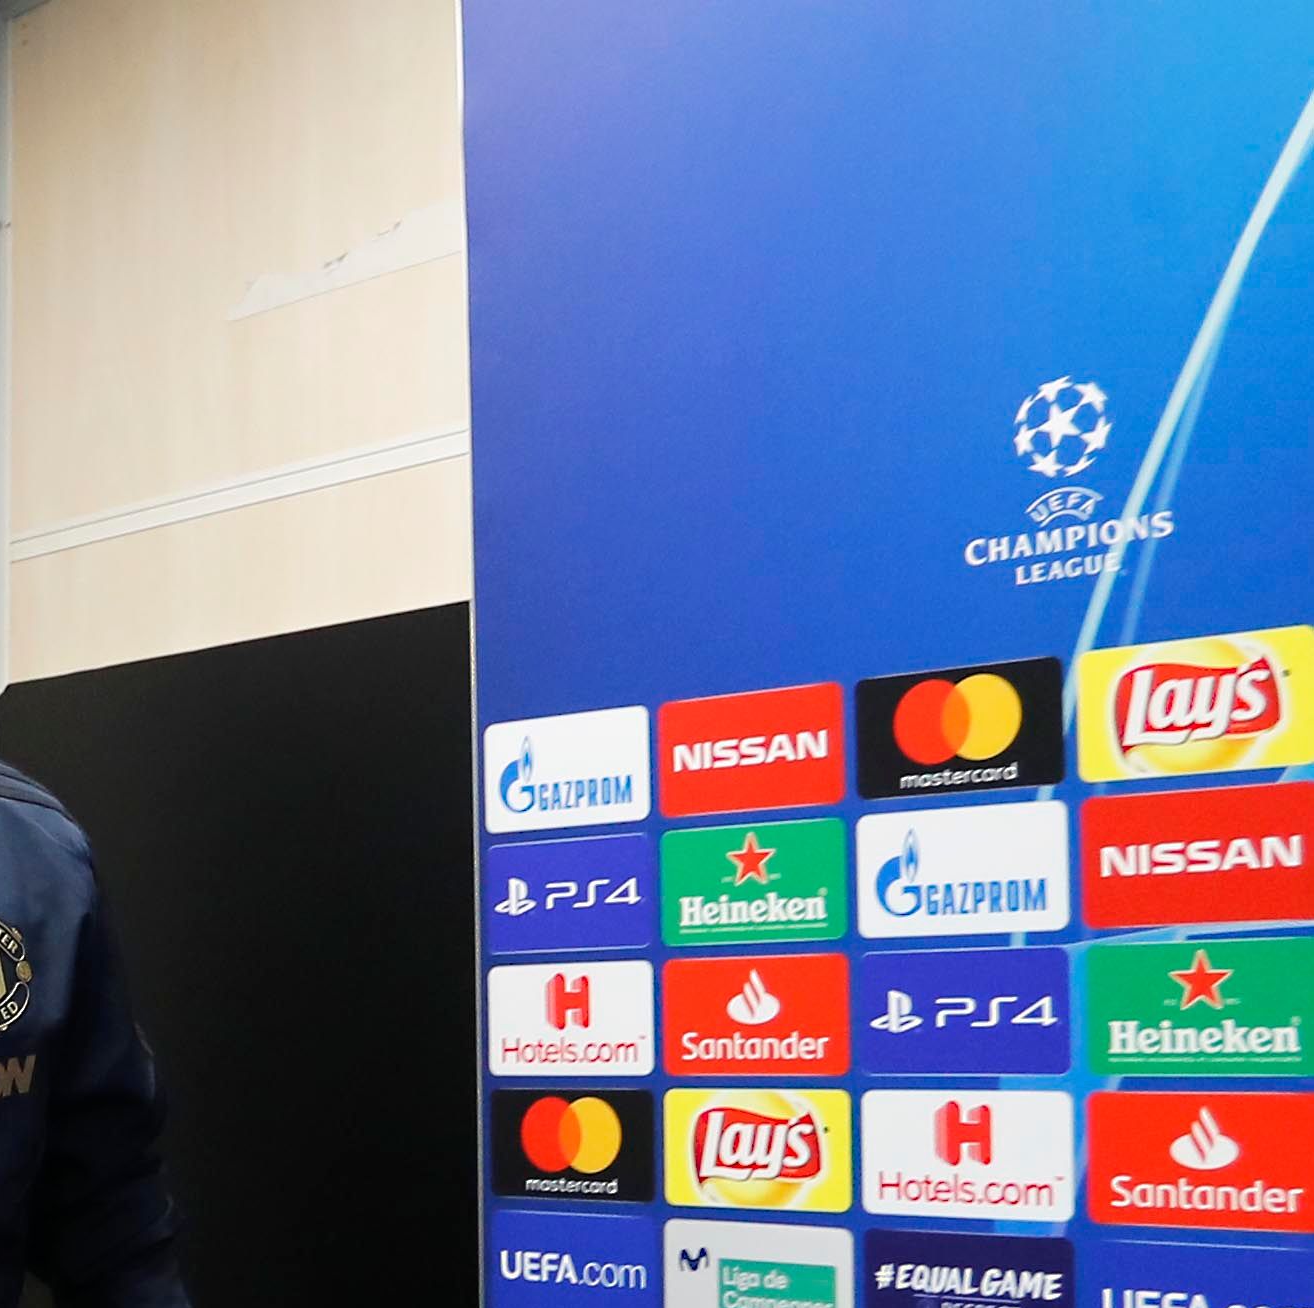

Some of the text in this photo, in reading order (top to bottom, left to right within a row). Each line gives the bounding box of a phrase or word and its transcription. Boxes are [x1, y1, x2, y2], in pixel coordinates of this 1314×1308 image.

[1028, 493, 1096, 522] UEFA
[964, 510, 1174, 566] CHAMPIONS
[1015, 551, 1121, 585] LEAGUE
[1123, 667, 1271, 746] Lay's
[672, 729, 829, 773] NISSAN
[539, 774, 633, 812] GAZPROM
[899, 762, 1019, 790] mastercard
[1100, 835, 1304, 878] NISSAN
[545, 877, 642, 910] PS4
[679, 889, 828, 927] Heineken
[926, 878, 1047, 916] GAZPROM
[934, 995, 1059, 1028] PS4
[501, 1036, 639, 1064] Hotels.com
[681, 1032, 829, 1061] Santander
[1108, 1018, 1301, 1055] Heineken
[699, 1111, 816, 1181] Lay's
[525, 1177, 619, 1194] mastercard
[878, 1171, 1055, 1208] Hotels.com
[1110, 1175, 1304, 1214] Santander
[500, 1250, 647, 1289] UEFA.com
[723, 1265, 789, 1291] Liga de
